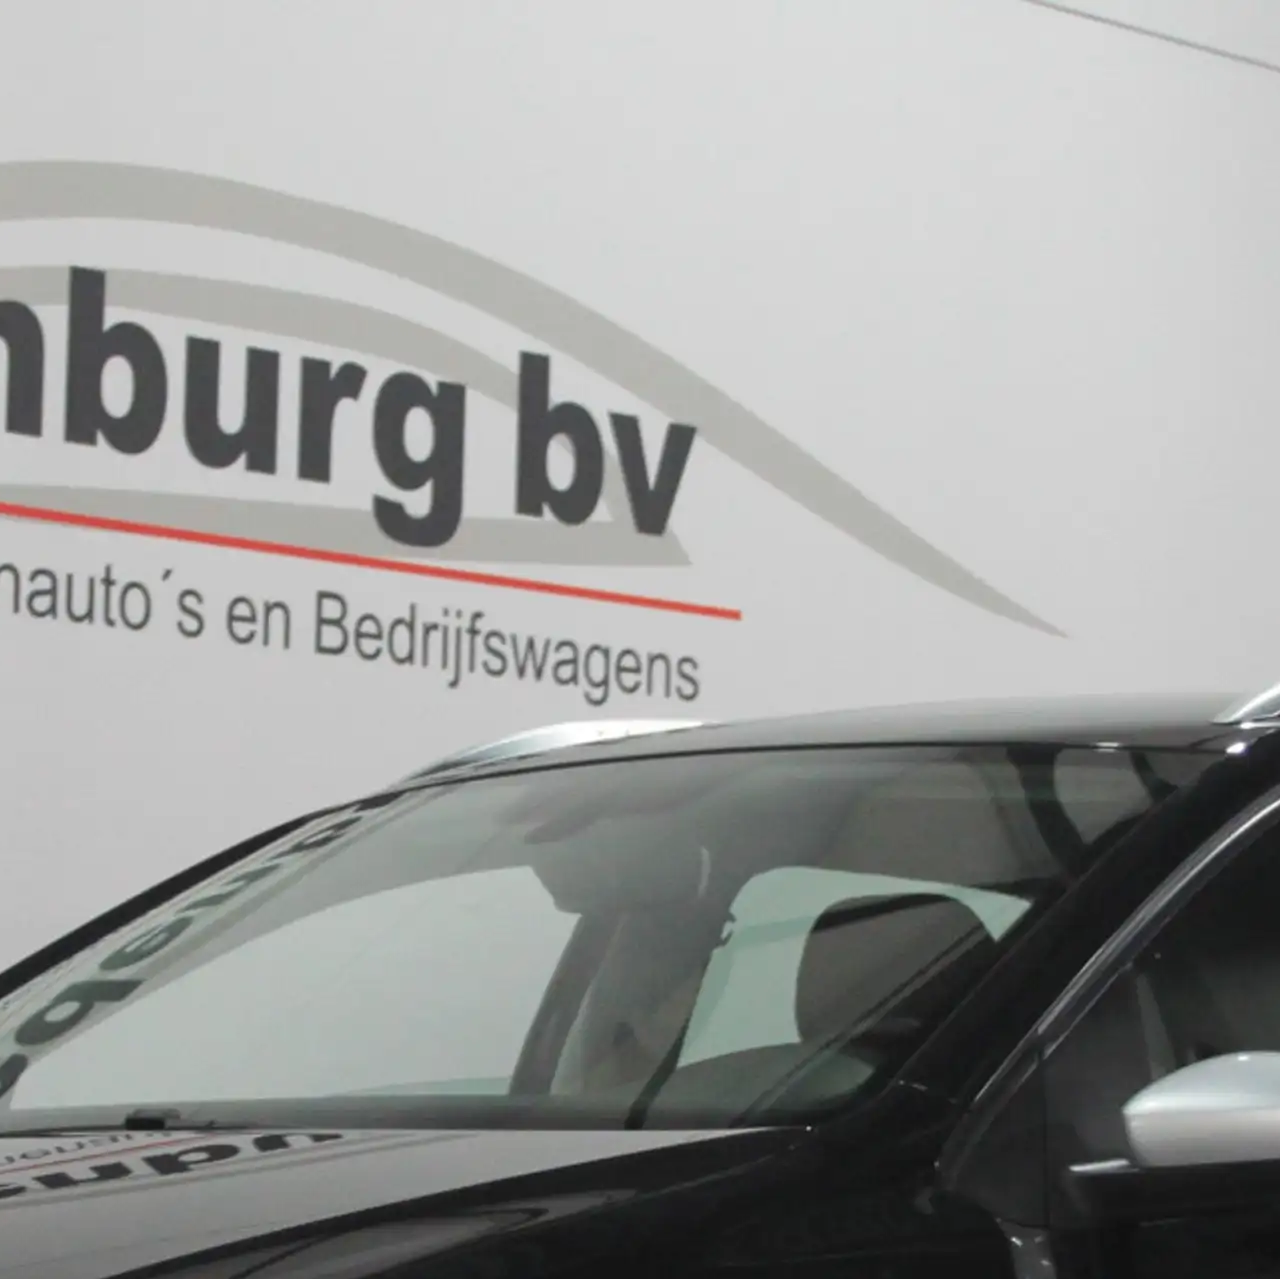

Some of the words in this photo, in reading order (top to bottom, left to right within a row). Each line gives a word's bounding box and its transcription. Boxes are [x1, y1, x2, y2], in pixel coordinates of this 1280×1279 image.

[515, 351, 697, 536] bv
[226, 594, 291, 649] en
[314, 591, 700, 706] Bedrijfswagens
